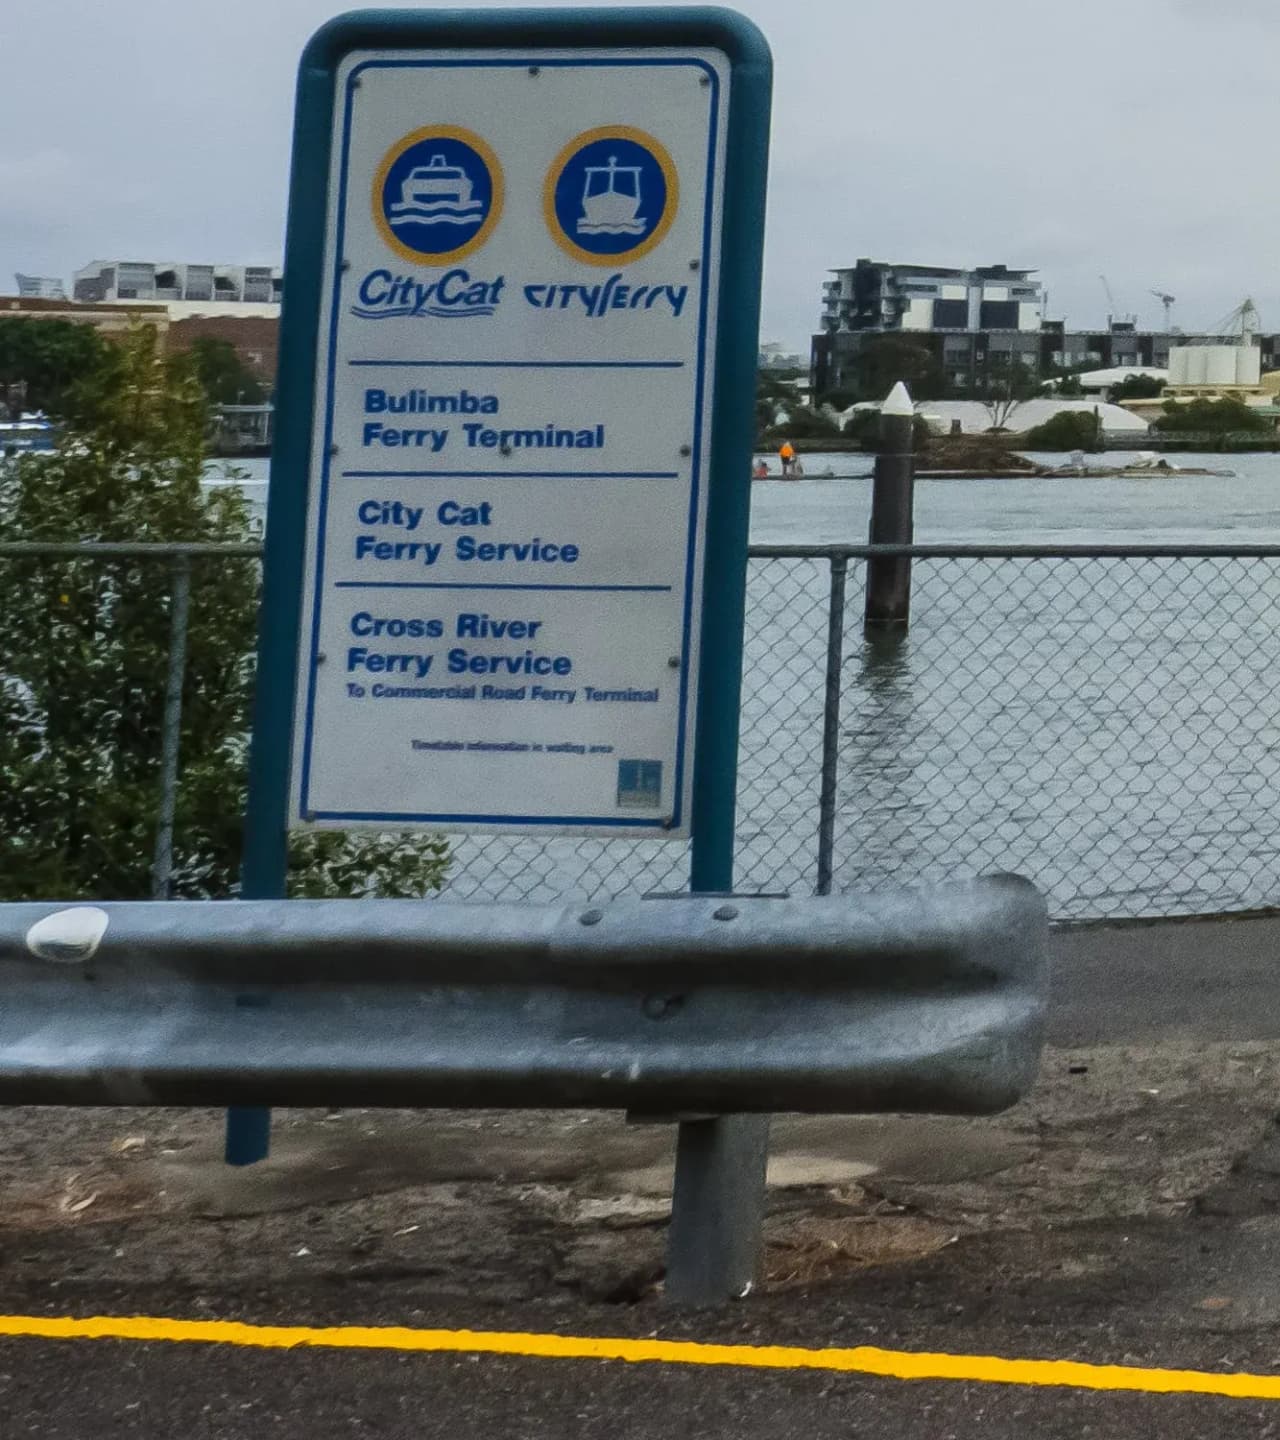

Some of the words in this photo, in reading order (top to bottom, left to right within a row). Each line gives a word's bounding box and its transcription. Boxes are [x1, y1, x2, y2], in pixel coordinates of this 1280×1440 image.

[359, 268, 505, 316] CityCat
[363, 389, 499, 415] Bulimba
[362, 422, 449, 453] Ferry
[462, 423, 605, 450] Terminal
[357, 500, 424, 531] City
[436, 500, 493, 528] Cat
[355, 535, 442, 566] Ferry
[455, 536, 580, 564] Service
[350, 612, 444, 639] Cross
[455, 613, 543, 640] River
[347, 647, 434, 679] Ferry
[447, 647, 573, 676] Service
[346, 682, 366, 699] To
[371, 683, 477, 701] Commercial
[480, 684, 527, 701] Road
[530, 685, 577, 704] Ferry
[583, 687, 660, 703] Terminal
